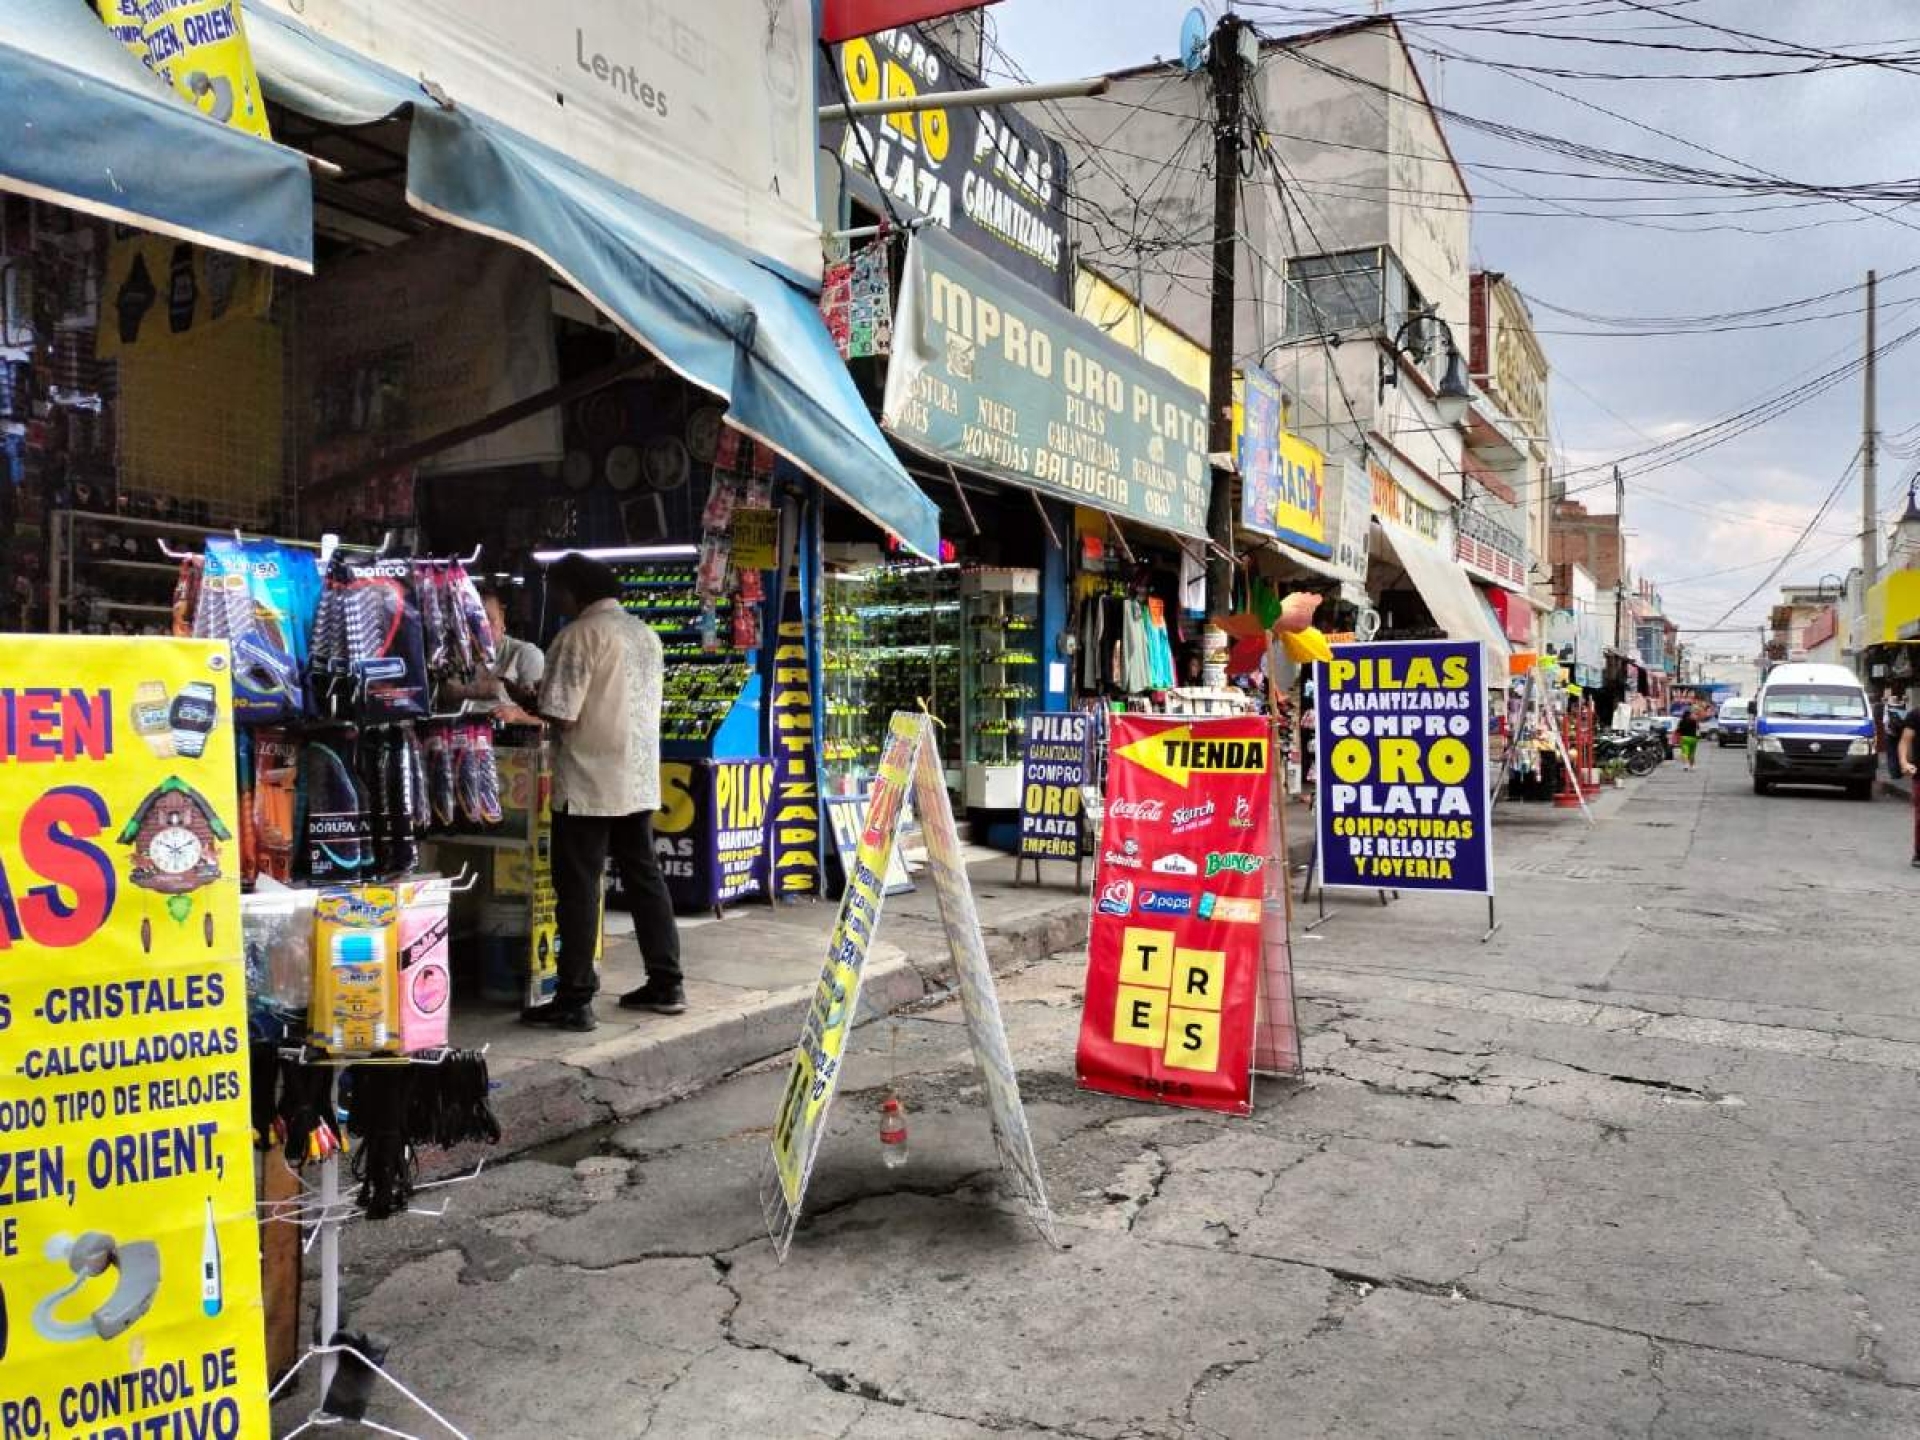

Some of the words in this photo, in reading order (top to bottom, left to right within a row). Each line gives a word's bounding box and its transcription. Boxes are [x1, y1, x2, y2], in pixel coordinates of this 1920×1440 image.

[576, 27, 667, 117] Lentes
[841, 37, 949, 168] ORO
[973, 108, 1053, 206] PILAS
[962, 168, 1062, 270] GARANTIZADAS
[1064, 347, 1124, 413] ORO
[1132, 384, 1208, 455] PLATA
[1067, 395, 1105, 436] PILAS
[961, 422, 1029, 472] MONEDAS
[1034, 447, 1129, 506] BALBUENA
[1328, 656, 1470, 690] PILAS
[1330, 691, 1470, 712] GARANTIZADAS
[1031, 716, 1085, 742] PILAS
[1330, 715, 1471, 737] COMPRO
[1028, 764, 1081, 783] COMPRO
[1163, 740, 1265, 770] TIENDA
[1330, 737, 1471, 785] ORO
[1025, 783, 1081, 817] ORO
[1331, 785, 1472, 815] PLATA
[1023, 816, 1077, 837] PLATA
[1332, 817, 1474, 840] COMPOSTURAS
[1021, 836, 1076, 856] EMPEÑOS
[1349, 837, 1374, 856] DE
[1377, 838, 1458, 860] RELOJES
[1354, 857, 1368, 877] Y
[1157, 895, 1192, 911] pepsi
[34, 972, 226, 1025] -CRISTALES
[16, 1026, 239, 1080] -CALCULADORAS
[54, 1089, 107, 1125] TIPO
[113, 1083, 142, 1116] DE
[148, 1070, 241, 1112] RELOJES
[87, 1121, 224, 1182] ORIENT,
[60, 1359, 195, 1429] CONTROL
[202, 1347, 237, 1393] DE
